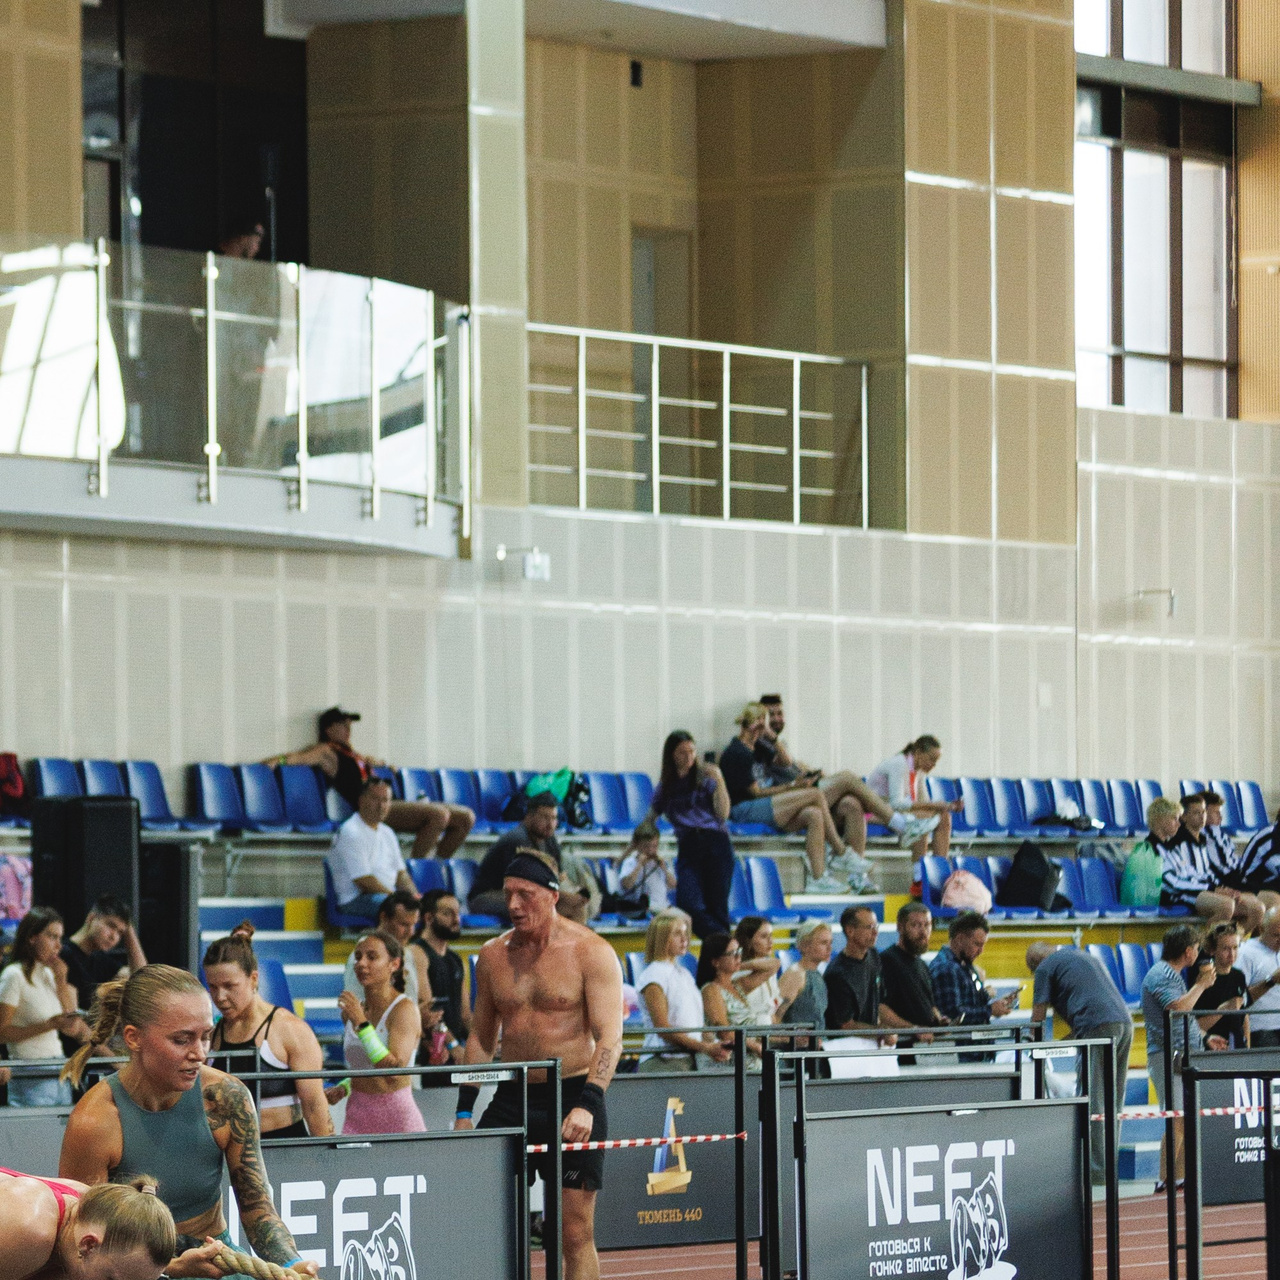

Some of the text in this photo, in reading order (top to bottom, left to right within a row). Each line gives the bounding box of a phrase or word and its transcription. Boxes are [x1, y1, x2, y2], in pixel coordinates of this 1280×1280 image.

[867, 1139, 1015, 1227] NEFT
[637, 1206, 703, 1225] ТЮМЕНЬ 440
